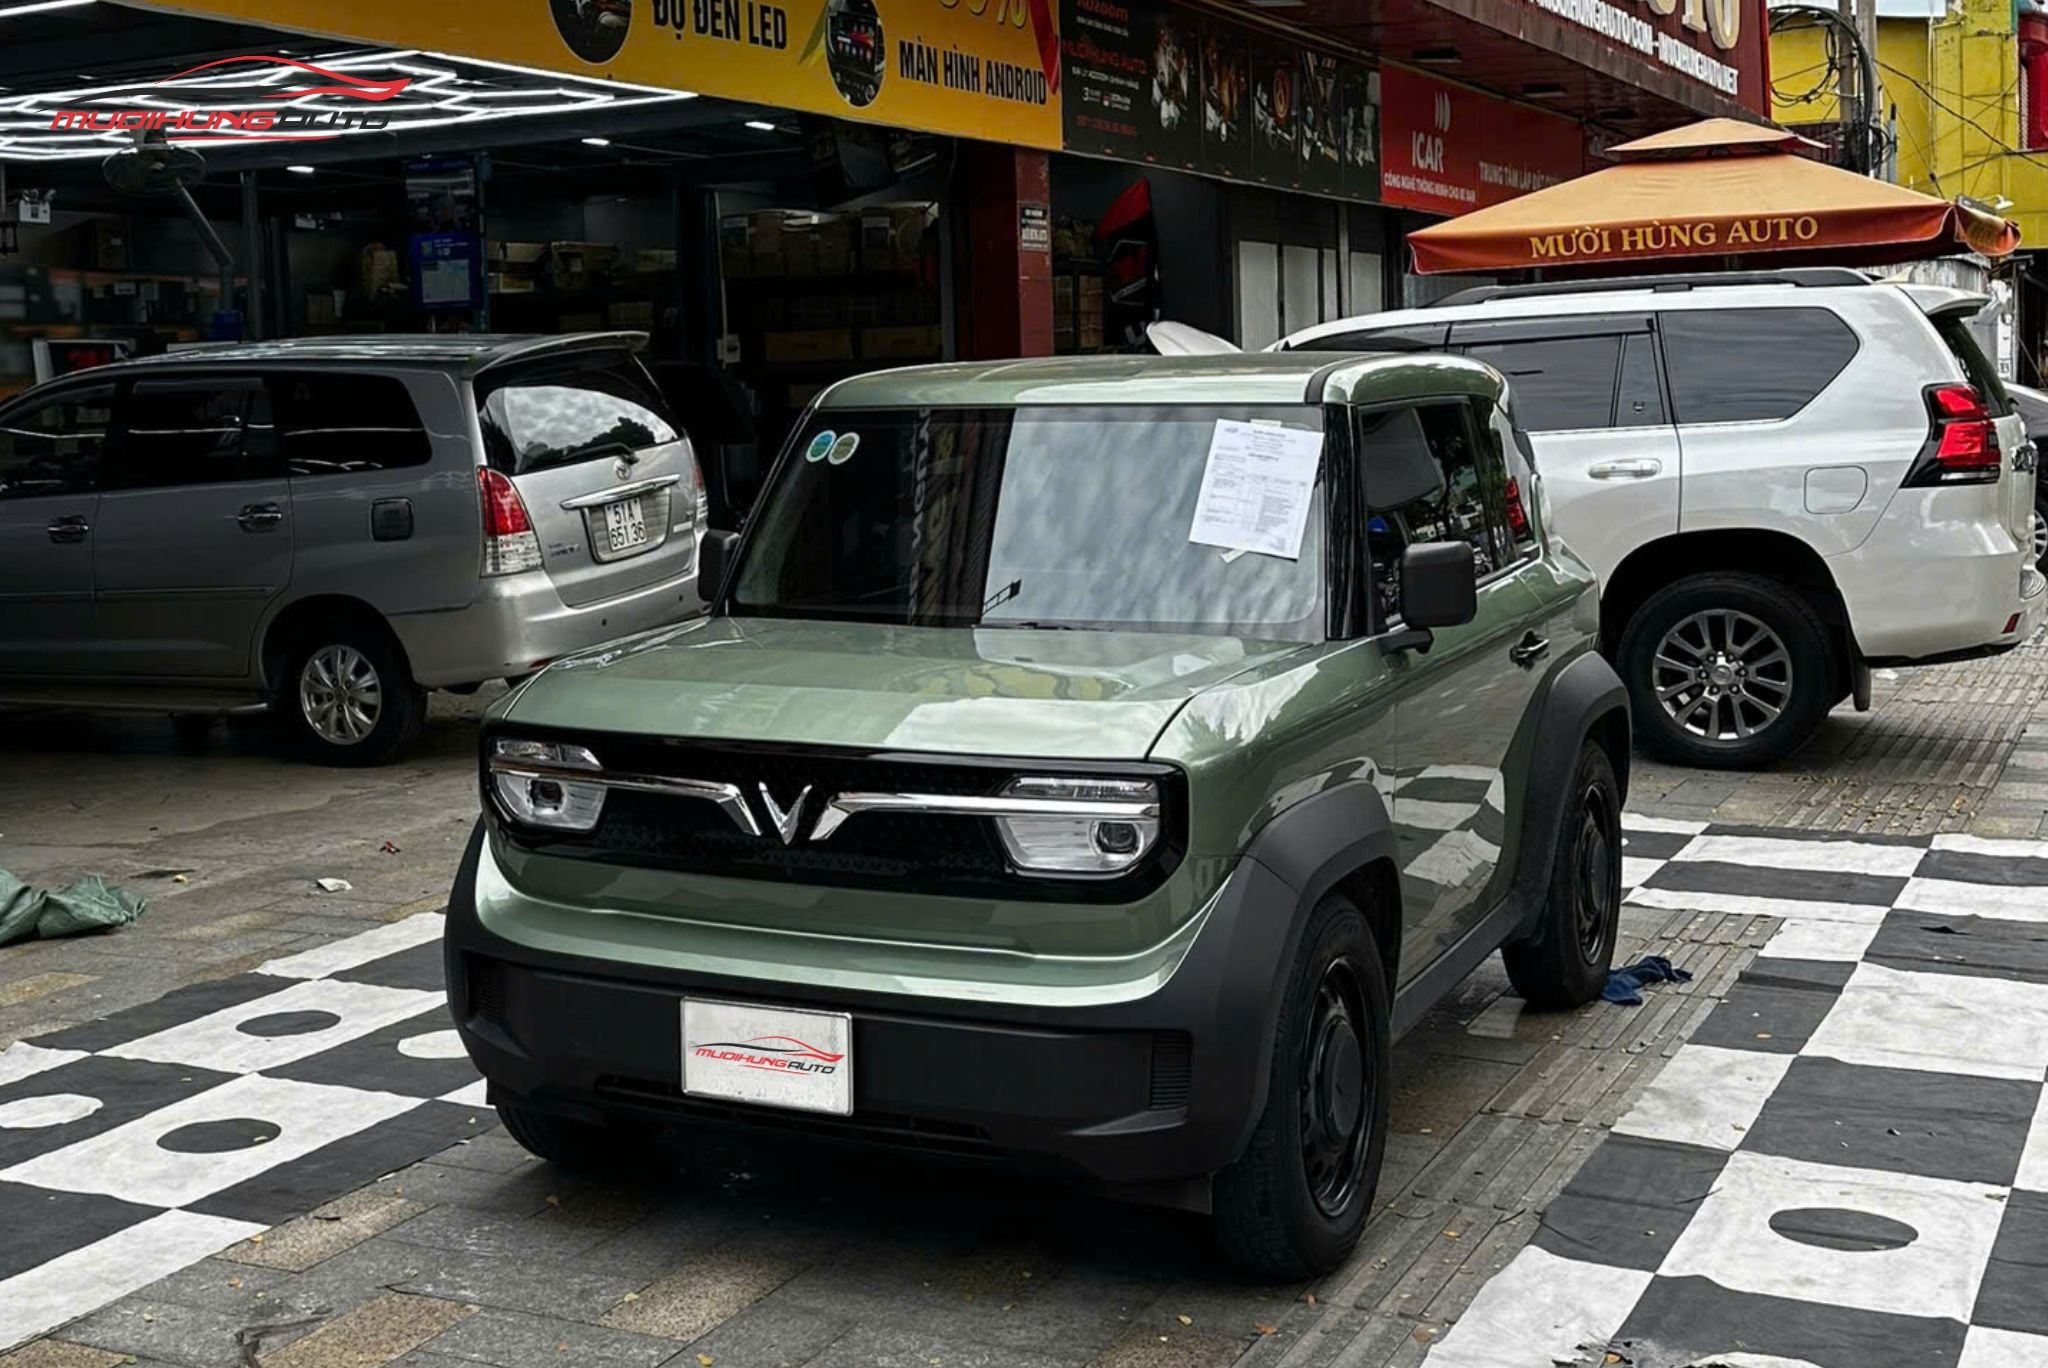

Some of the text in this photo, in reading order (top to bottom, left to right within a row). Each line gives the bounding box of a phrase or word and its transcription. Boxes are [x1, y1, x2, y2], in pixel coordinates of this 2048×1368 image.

[748, 1, 787, 49] LED
[900, 36, 939, 85] MÀN
[943, 43, 980, 93] HÌNH
[985, 60, 1048, 106] ANDROID
[1412, 131, 1444, 173] ICAR
[1530, 216, 1818, 258] MƯỜI HÙNG AUTO
[613, 501, 636, 524] 51A
